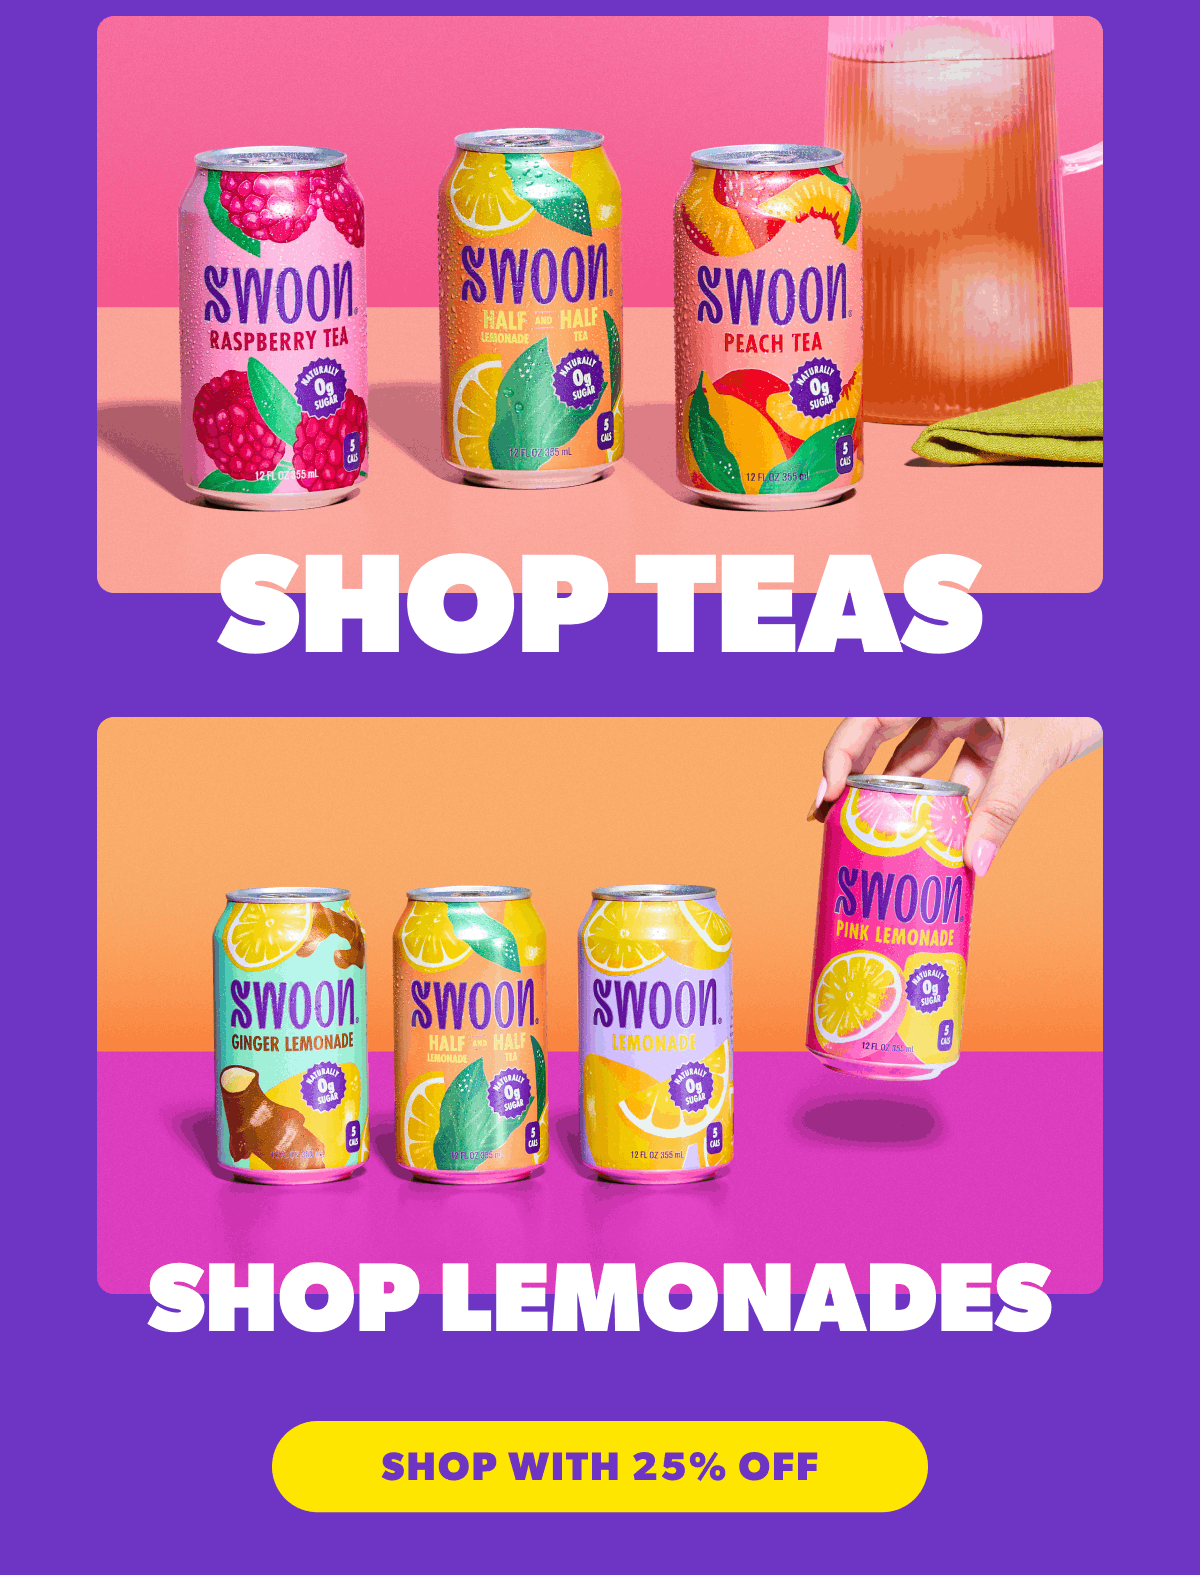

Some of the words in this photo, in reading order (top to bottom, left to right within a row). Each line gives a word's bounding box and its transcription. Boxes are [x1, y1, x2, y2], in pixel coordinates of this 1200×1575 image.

[461, 242, 608, 305] SWOON
[204, 260, 352, 324] SWOON
[697, 262, 846, 326] SWOON
[483, 309, 527, 330] HALF
[535, 316, 553, 325] AND
[560, 307, 598, 329] HALF
[210, 329, 316, 351] RASPBERRY
[324, 326, 349, 348] TEA
[481, 332, 529, 344] LEMONADE
[574, 330, 588, 342] TEA
[724, 333, 784, 353] PEACH
[792, 331, 823, 352] TEA
[559, 356, 597, 377] NATURALLY
[796, 365, 835, 385] NATURALLY
[300, 365, 339, 387] NATURALLY
[573, 369, 591, 387] 0g
[314, 378, 334, 396] 0g
[573, 385, 596, 400] SUGAR
[810, 378, 829, 396] 0g
[314, 395, 338, 411] SUGAR
[810, 394, 833, 410] SUGAR
[603, 418, 609, 431] 5
[842, 442, 849, 455] 5
[835, 865, 963, 924] SWOON
[836, 920, 869, 941] PINK
[875, 926, 955, 946] LEMONADE
[911, 970, 945, 986] NATURALLY
[923, 980, 939, 995] 0g
[230, 977, 355, 1030] SWOON
[410, 978, 535, 1030] SWOON
[593, 978, 717, 1029] SWOON
[921, 995, 941, 1007] SUGAR
[231, 1035, 279, 1052] GINGER
[285, 1032, 354, 1052] LEMONADE
[429, 1034, 466, 1052] HALF
[493, 1032, 526, 1051] HALF
[612, 1034, 697, 1051] LEMONADE
[427, 1053, 468, 1063] LEMONADE
[505, 1052, 518, 1062] TEA
[305, 1068, 340, 1084] NATURALLY
[493, 1073, 525, 1091] NATURALLY
[673, 1068, 708, 1085] NATURALLY
[317, 1078, 335, 1093] 0g
[504, 1085, 520, 1100] 0g
[686, 1078, 702, 1093] 0g
[317, 1093, 339, 1104] SUGAR
[504, 1099, 524, 1112] SUGAR
[685, 1092, 706, 1105] SUGAR
[712, 1127, 718, 1138] 5
[631, 1151, 638, 1159] 12
